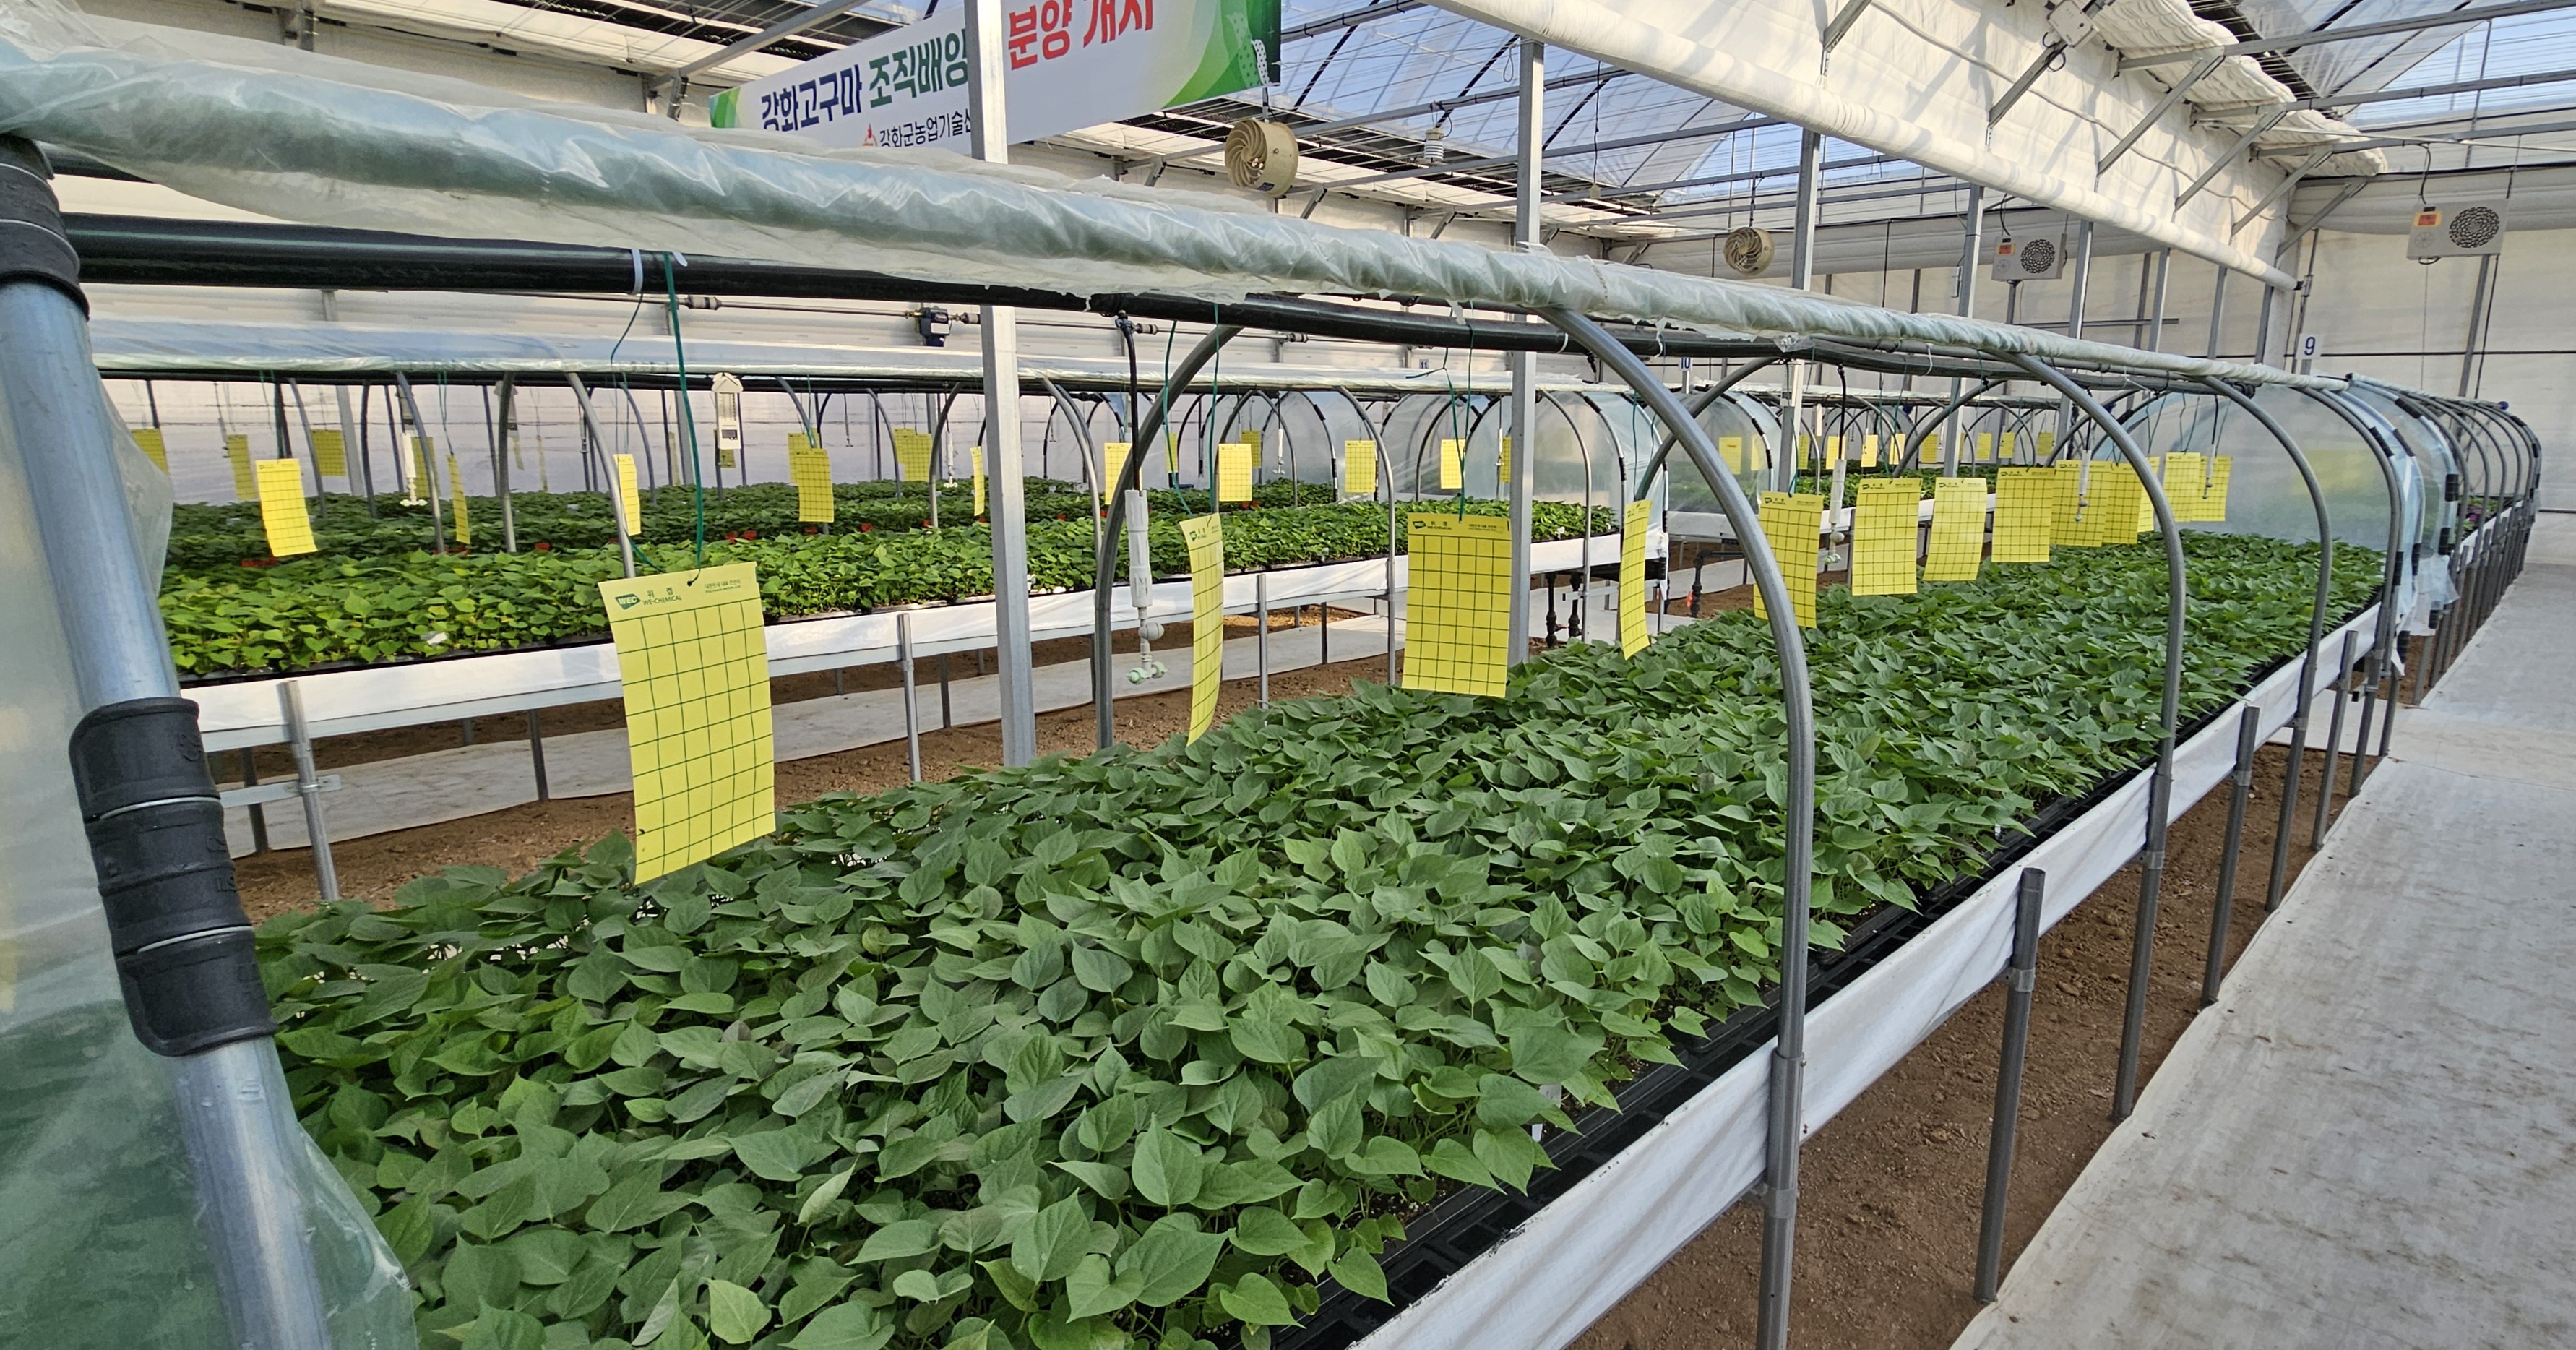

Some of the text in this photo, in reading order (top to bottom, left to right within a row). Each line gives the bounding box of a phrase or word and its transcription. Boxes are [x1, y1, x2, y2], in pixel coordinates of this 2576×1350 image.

[762, 64, 862, 132] 강화고구마
[1009, 0, 1072, 70] 분양
[2304, 336, 2316, 356] 9
[618, 596, 637, 605] WEC
[642, 595, 682, 606] WE-CHEMICAL
